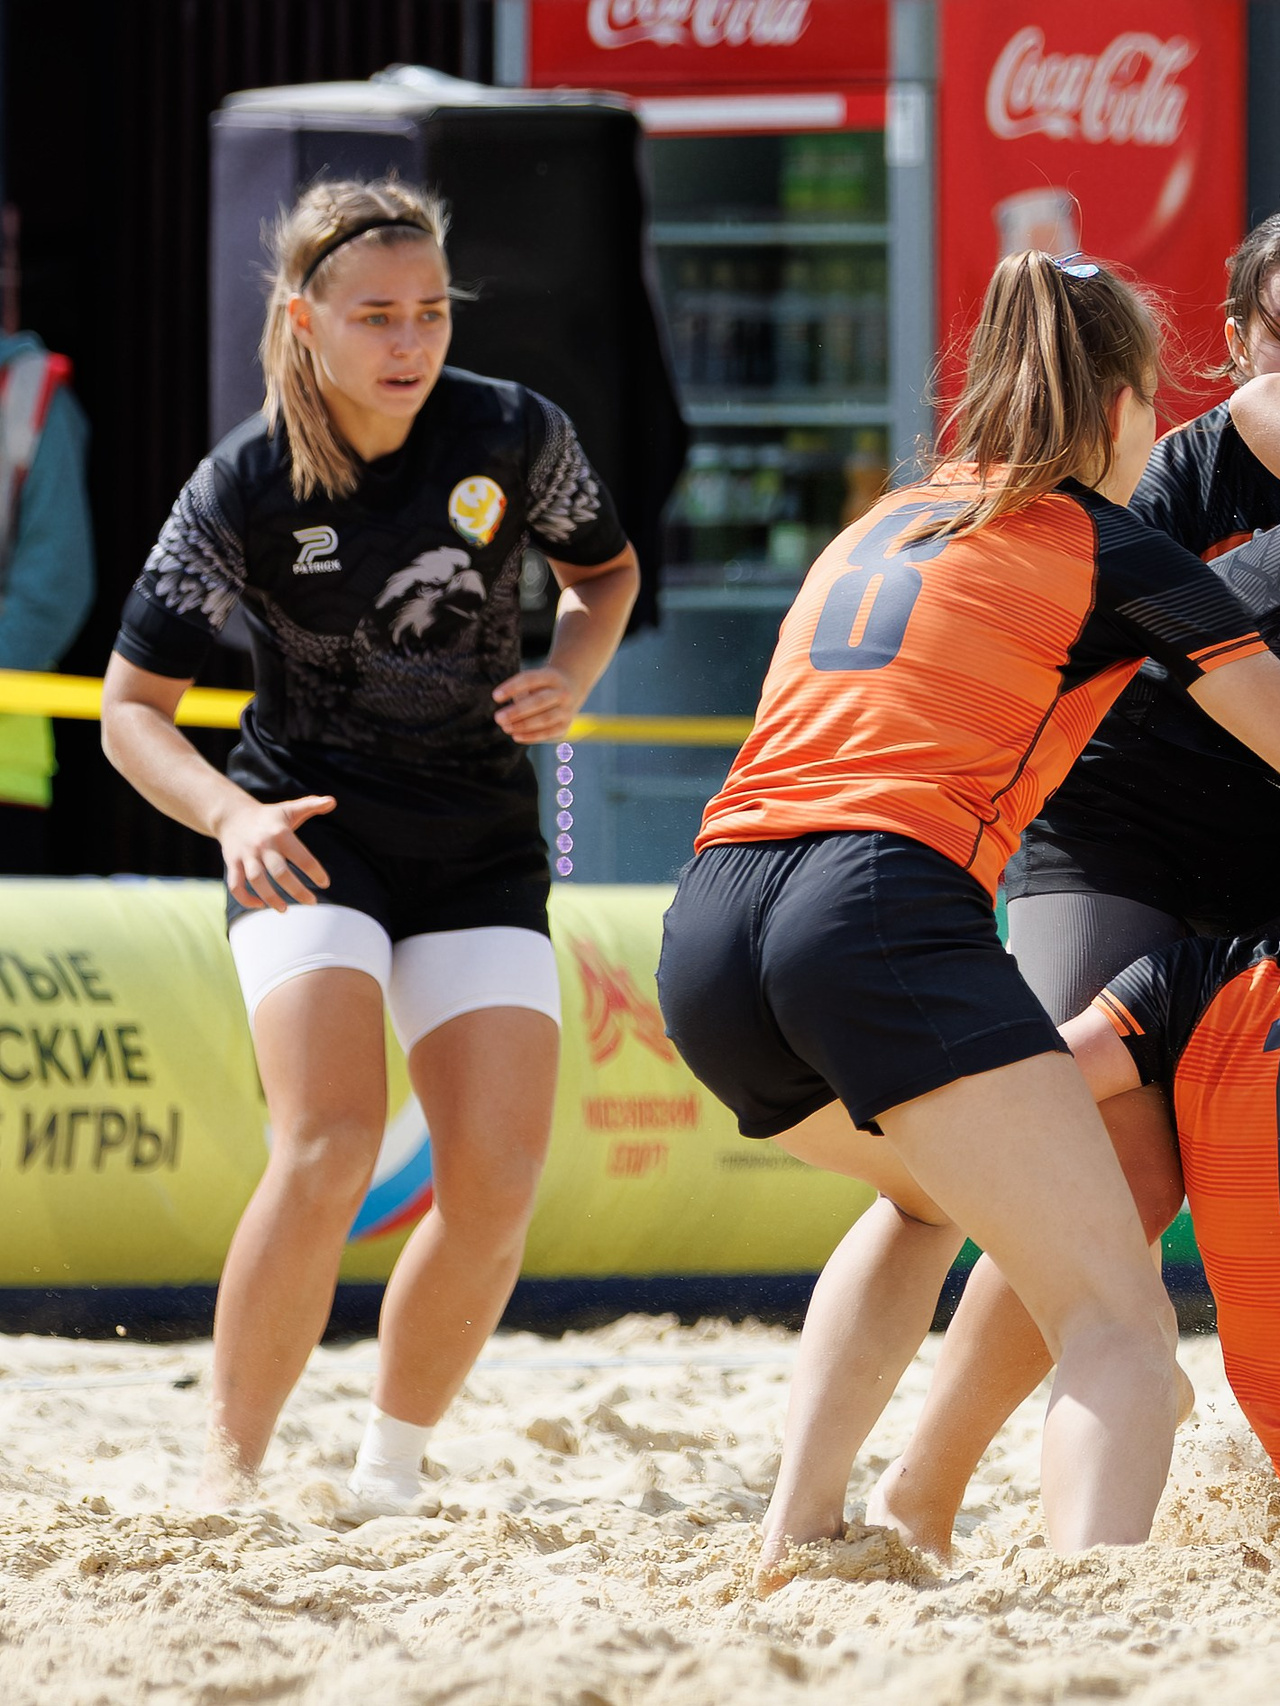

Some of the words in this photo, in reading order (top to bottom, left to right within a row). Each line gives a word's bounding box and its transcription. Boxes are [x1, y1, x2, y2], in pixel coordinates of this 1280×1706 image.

[985, 24, 1198, 147] Coca-Cola
[809, 500, 977, 672] 8
[0, 1024, 152, 1085] СКИЕ
[20, 1108, 180, 1171] ИГРЫ
